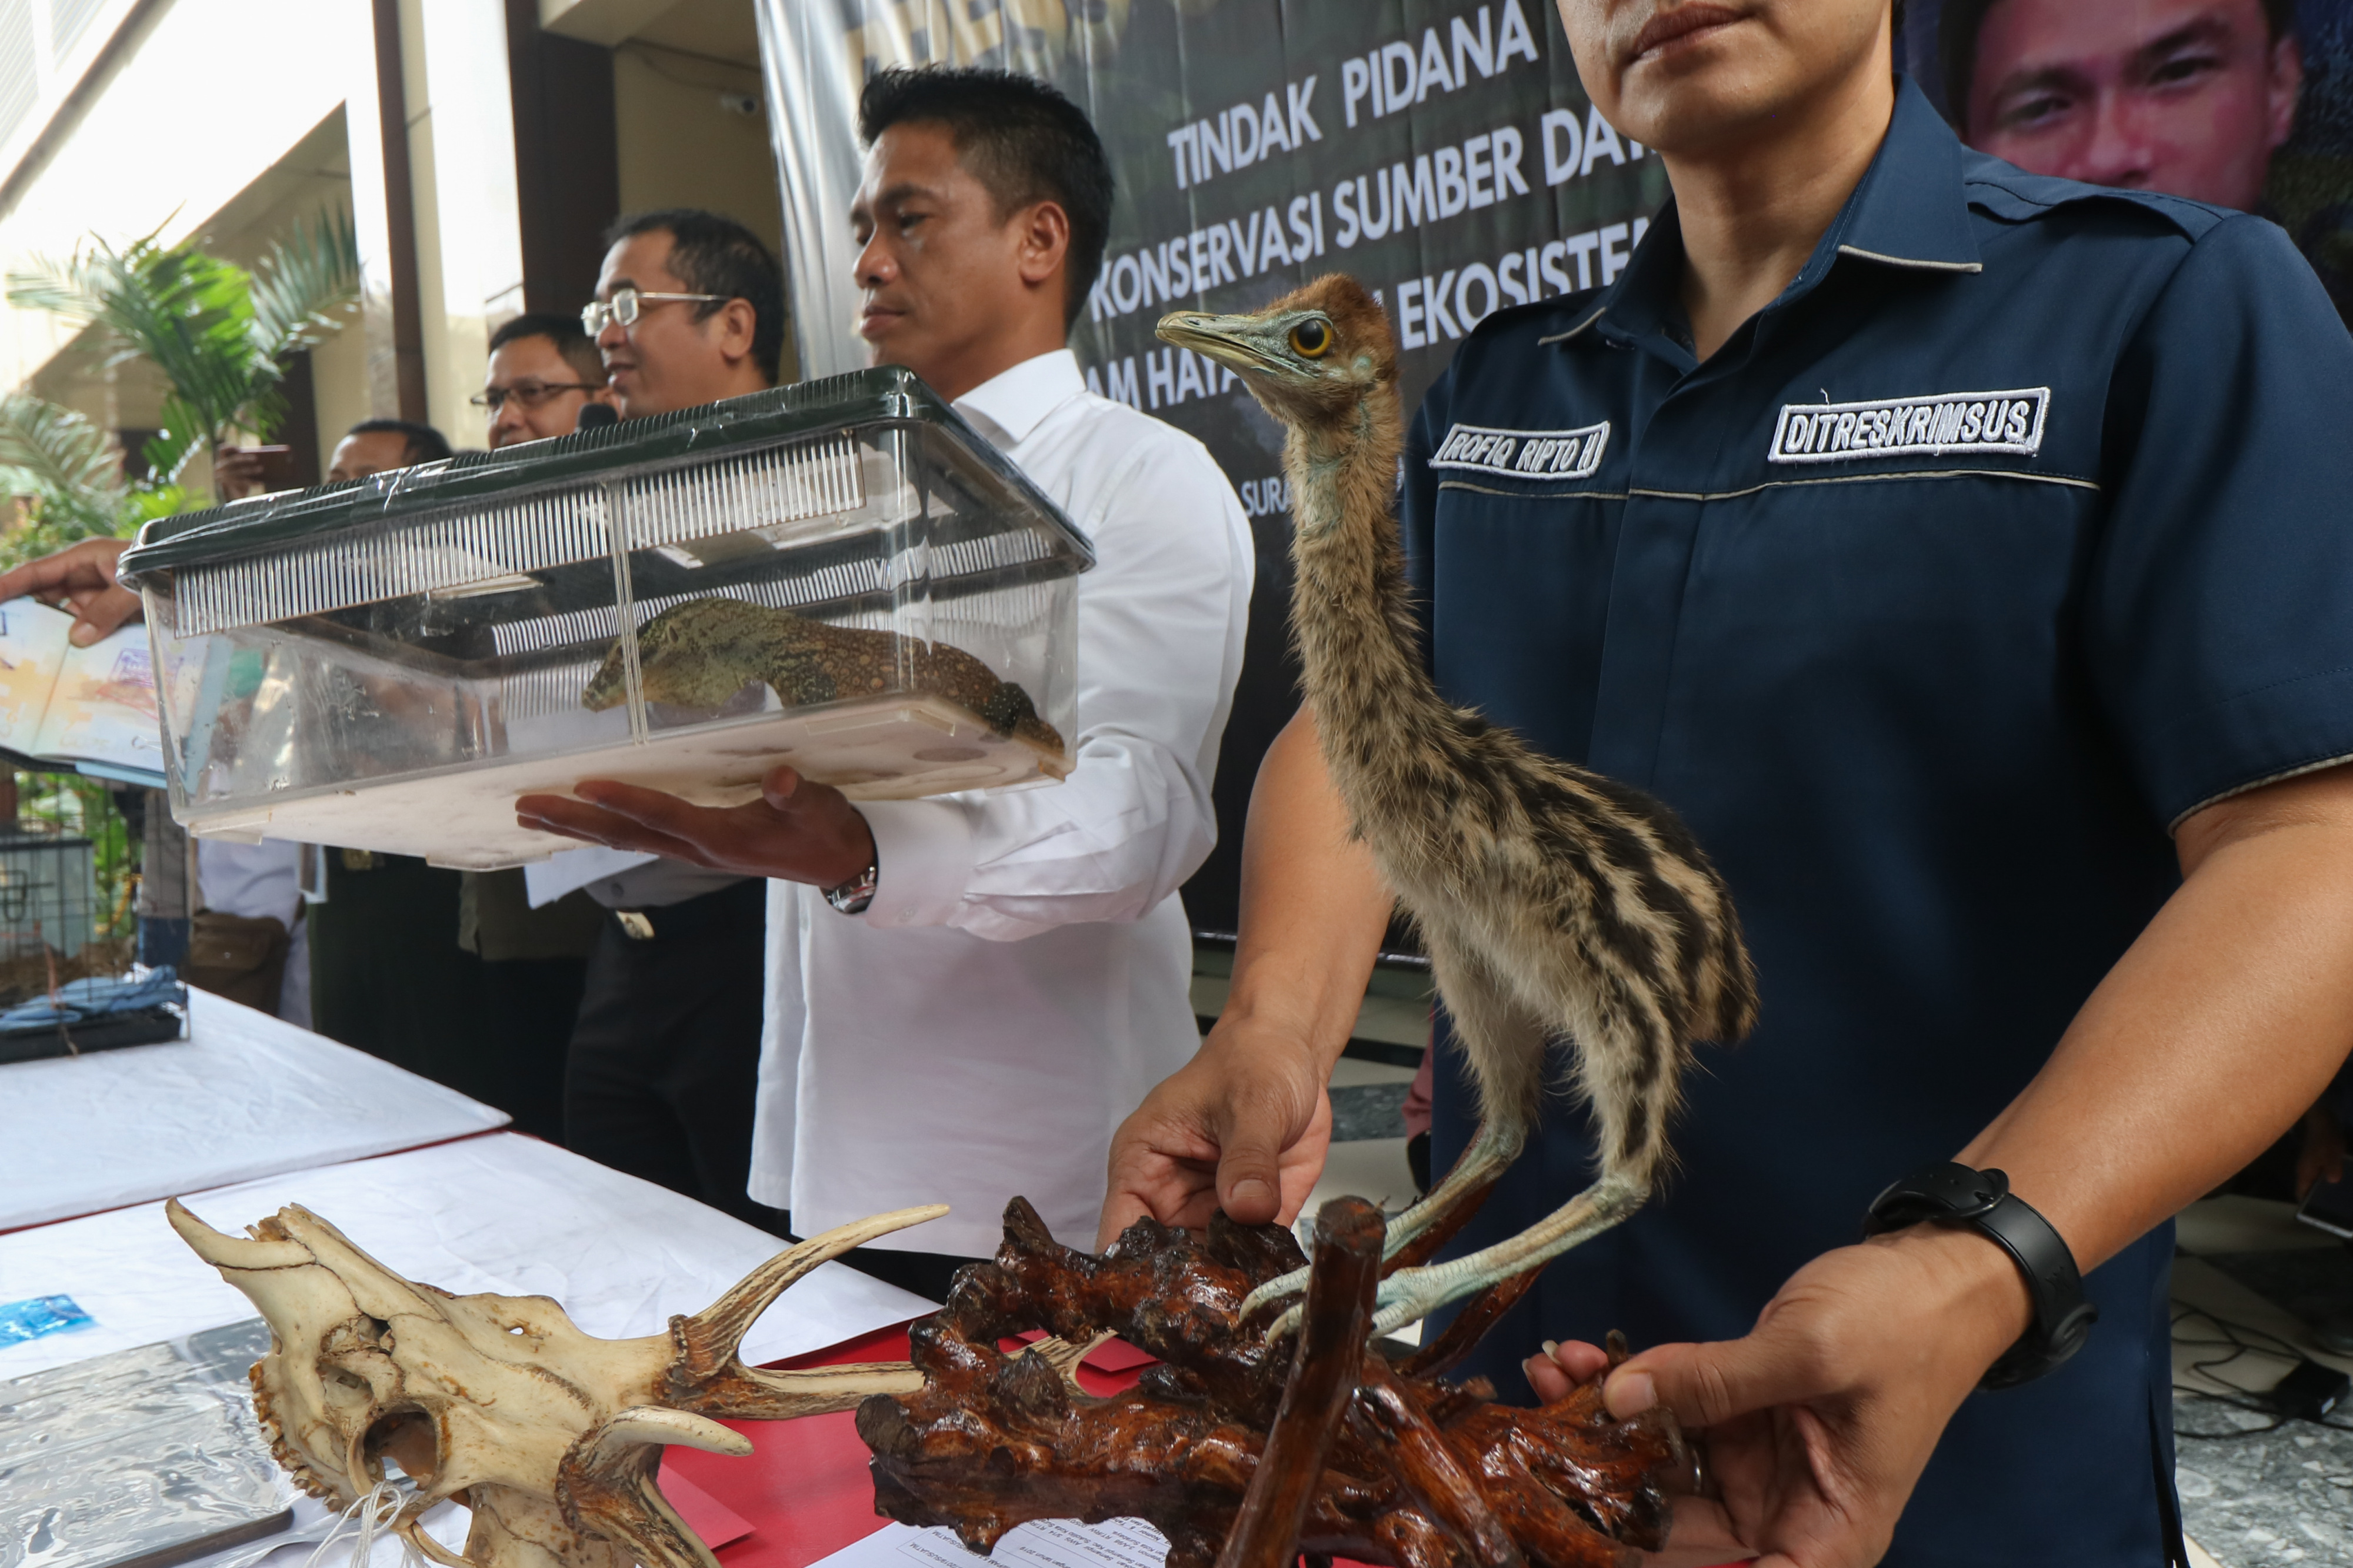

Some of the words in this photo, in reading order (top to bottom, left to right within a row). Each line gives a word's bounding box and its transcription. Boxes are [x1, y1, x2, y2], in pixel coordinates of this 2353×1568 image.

[1167, 75, 1323, 190] TINDAK
[1342, 0, 1538, 128] PIDANA
[1091, 191, 1325, 323] KONSERVASI
[1333, 125, 1529, 249] SUMBER
[1541, 104, 1645, 186] DA
[1444, 432, 1517, 468] ROFIQ
[1516, 438, 1579, 472] RIPTO
[1785, 399, 2030, 453] DITRESKRIMSUS
